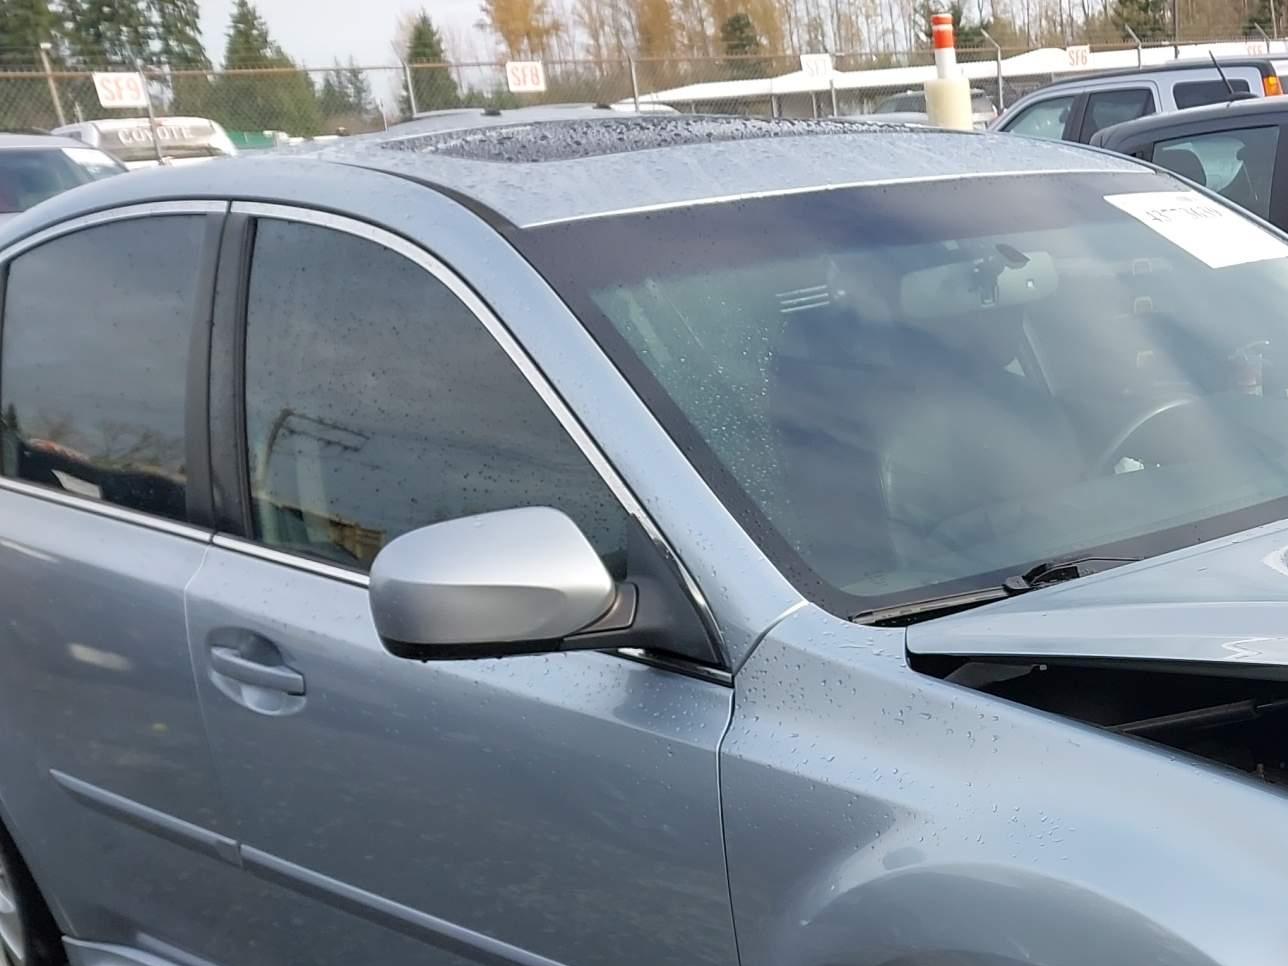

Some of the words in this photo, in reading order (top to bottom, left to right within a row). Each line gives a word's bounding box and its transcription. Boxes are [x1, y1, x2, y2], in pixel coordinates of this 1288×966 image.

[1068, 48, 1088, 66] SF6
[511, 64, 541, 86] SF8
[100, 77, 141, 101] SF9
[118, 126, 194, 145] COYOTE
